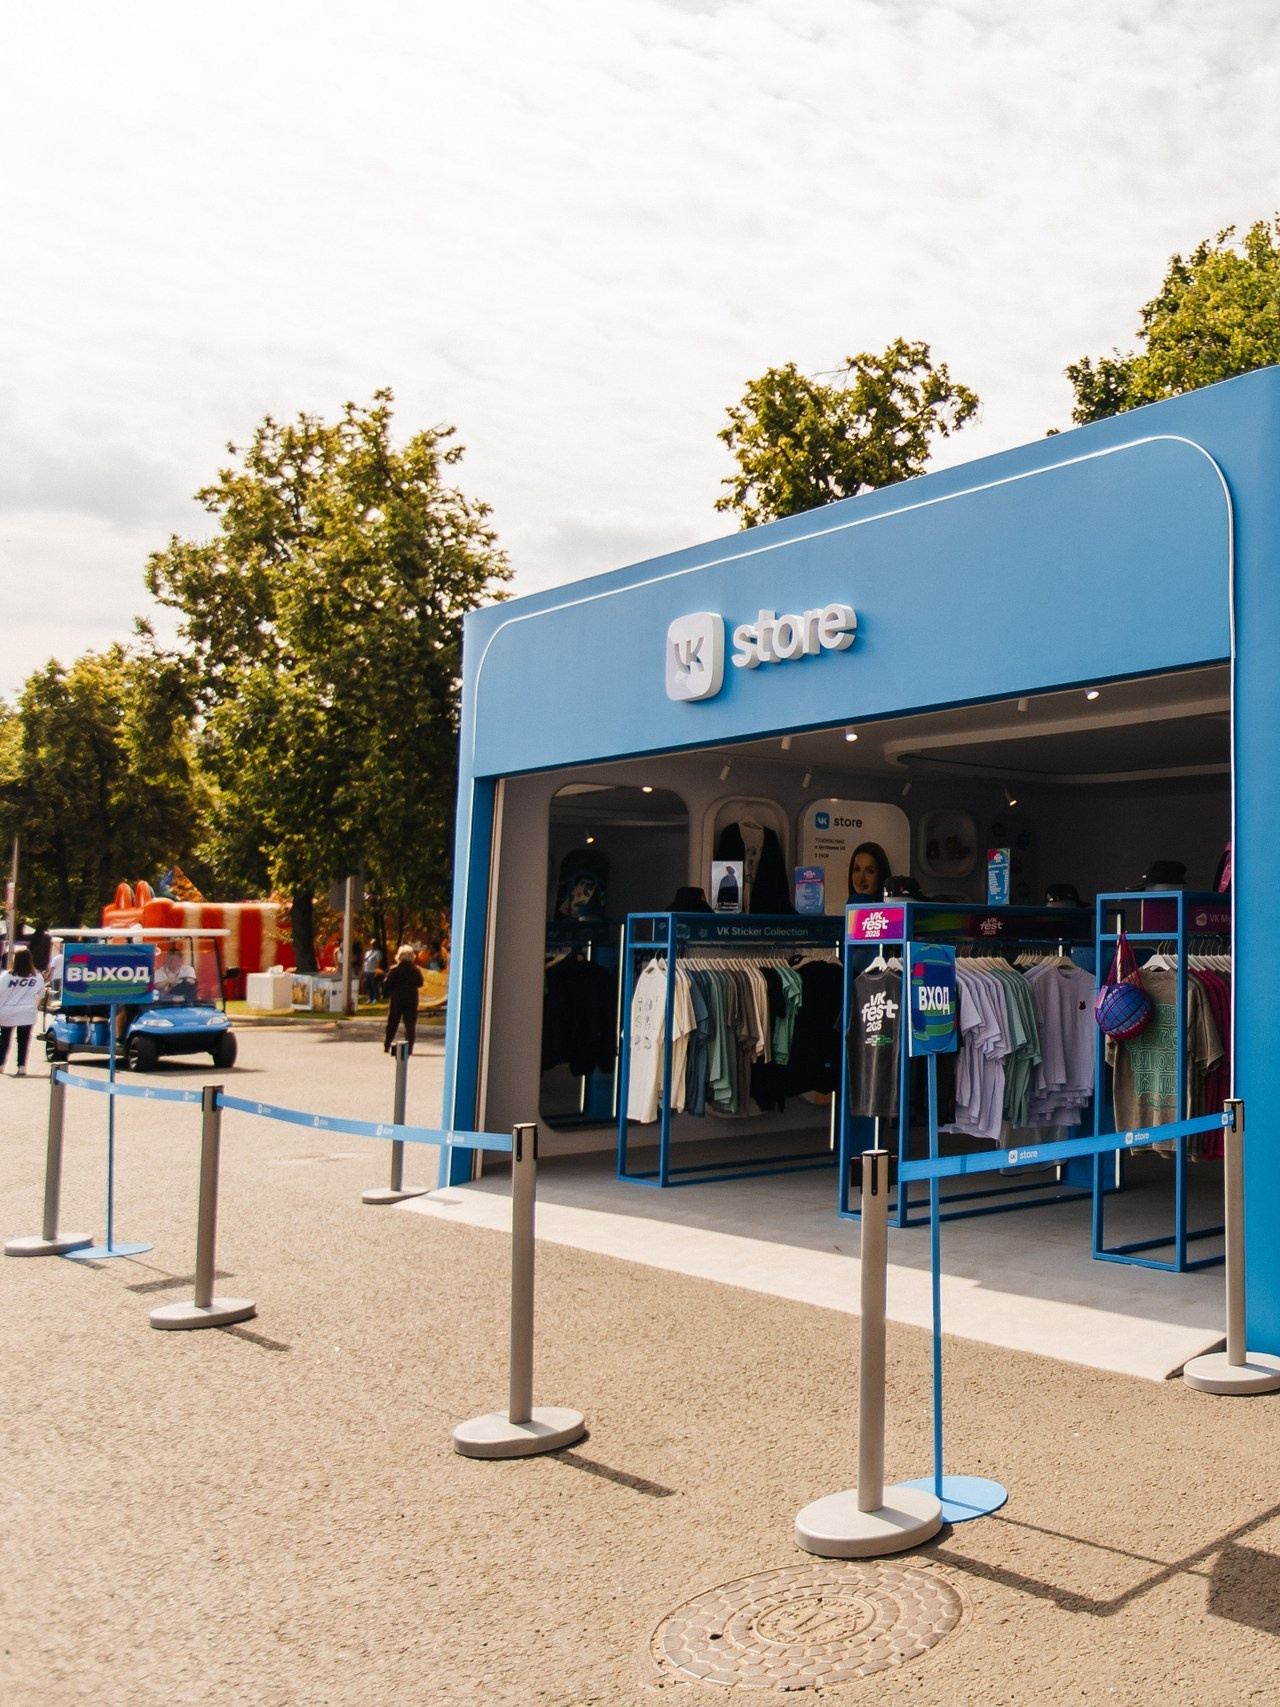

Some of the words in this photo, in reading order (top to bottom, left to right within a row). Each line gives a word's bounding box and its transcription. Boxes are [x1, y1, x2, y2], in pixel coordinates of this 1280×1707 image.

[732, 603, 857, 669] store
[833, 816, 863, 828] store
[869, 911, 883, 920] VK
[861, 916, 889, 931] fest
[980, 920, 1004, 931] fest
[717, 926, 730, 936] VK
[732, 926, 762, 936] Sticker
[764, 926, 808, 936] Collection
[865, 930, 881, 938] 2025
[66, 966, 150, 983] ВЫХОД
[869, 990, 887, 1004] VK
[918, 986, 951, 1015] ВХОД
[861, 999, 899, 1023] fest
[1134, 1132, 1150, 1142] store
[1019, 1150, 1038, 1160] store
